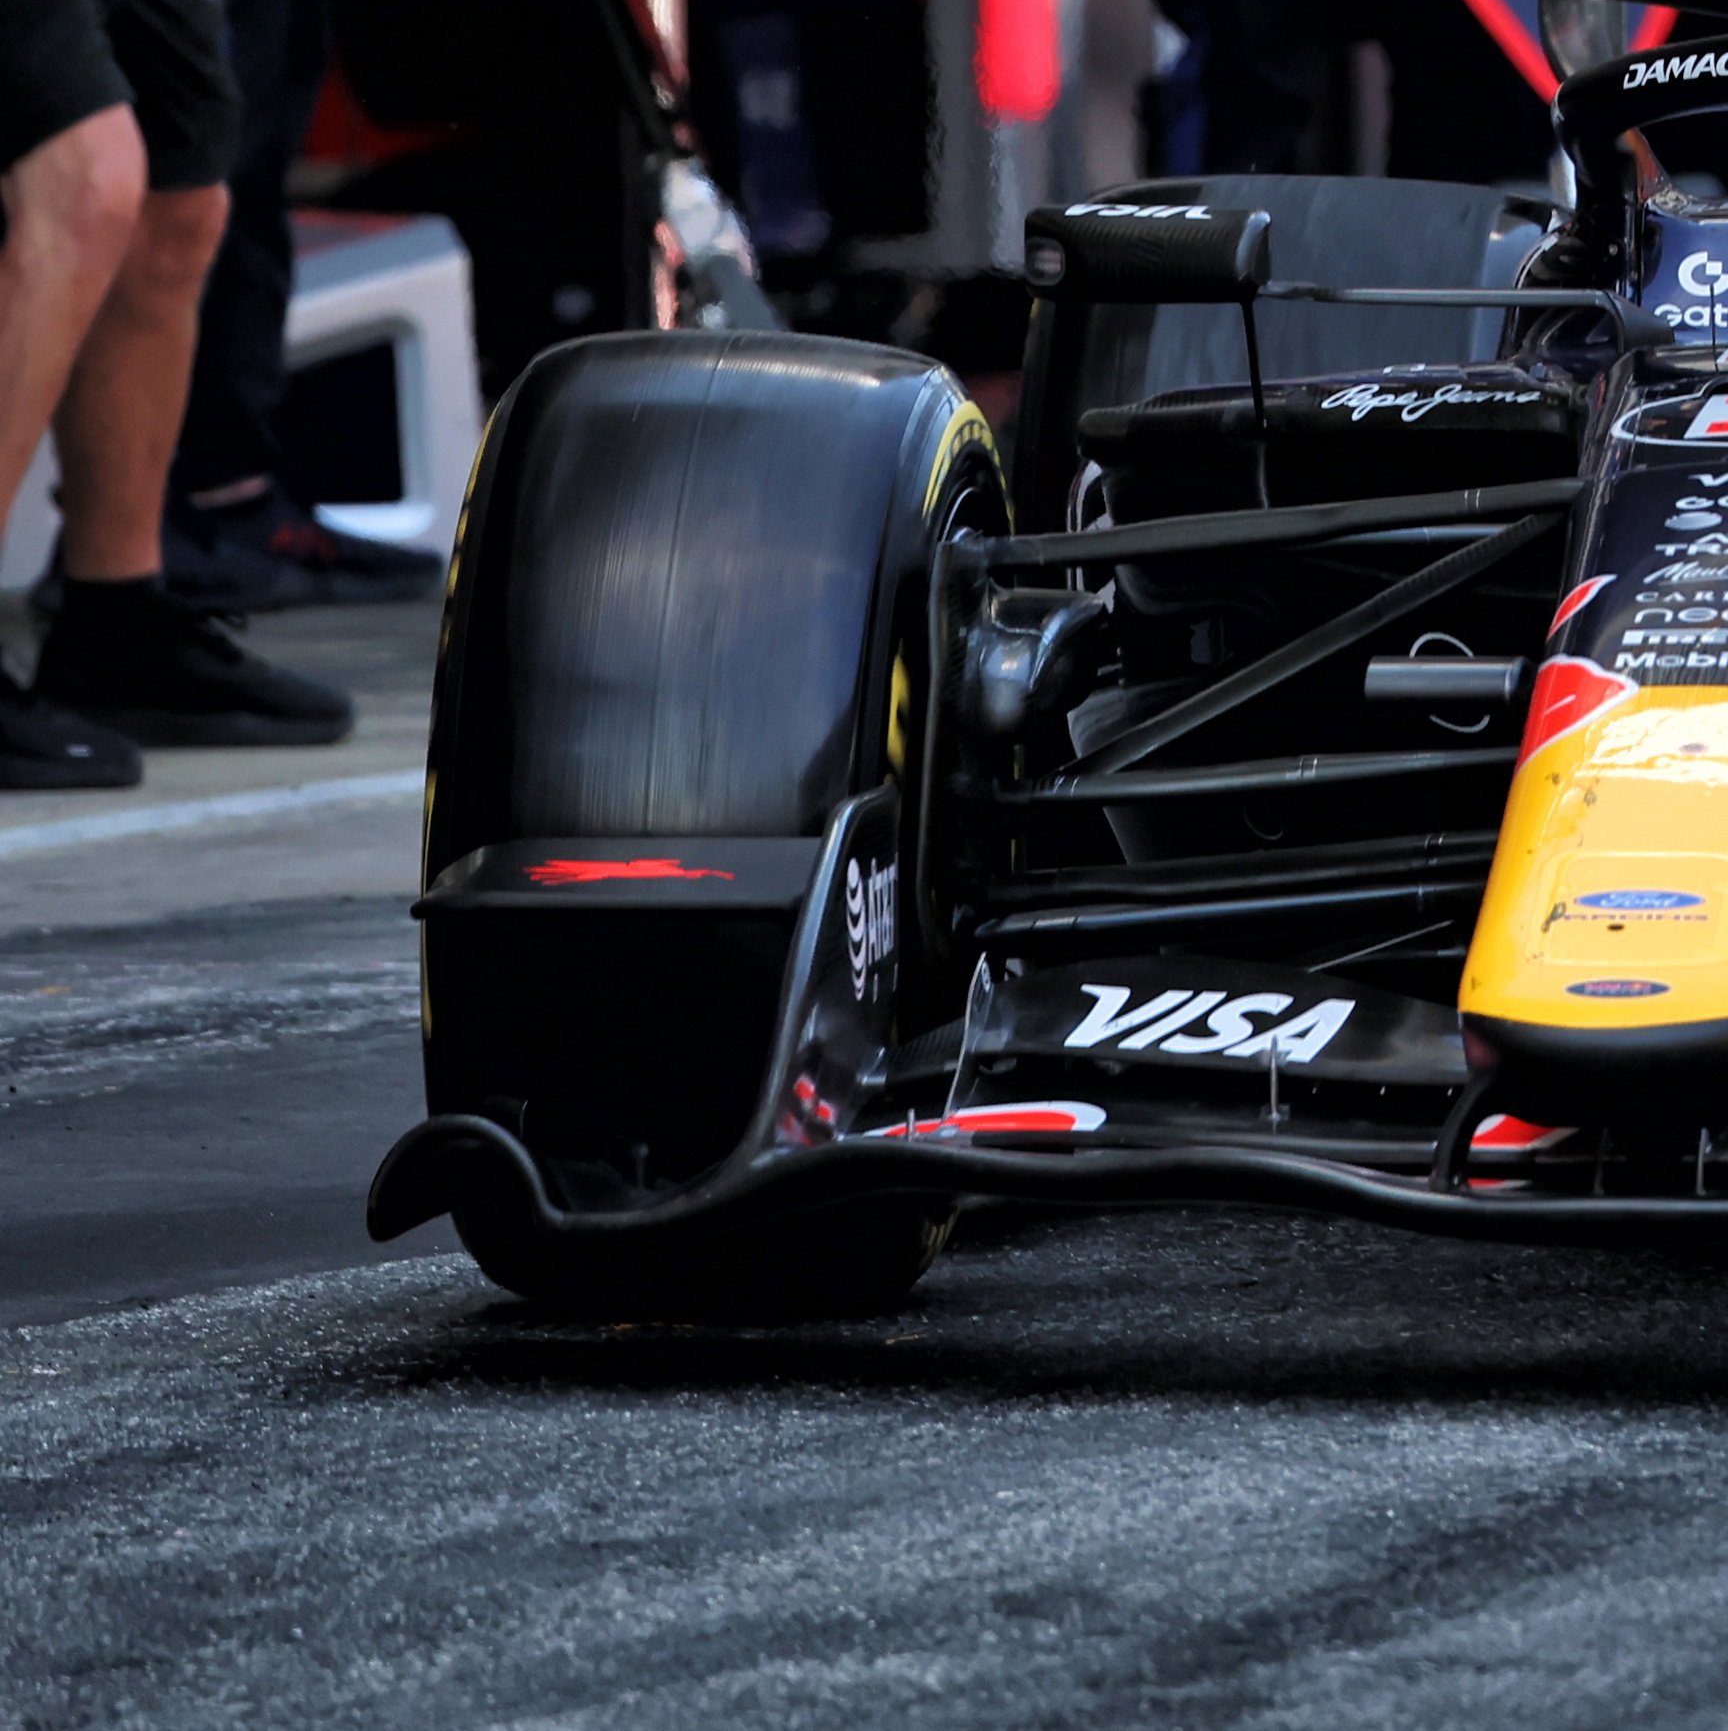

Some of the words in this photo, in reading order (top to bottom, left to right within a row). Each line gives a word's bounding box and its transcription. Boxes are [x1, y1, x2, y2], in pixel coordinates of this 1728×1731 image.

[1320, 384, 1417, 421] Pepe
[1402, 384, 1540, 421] Jeans
[1064, 984, 1356, 1063] VISA
